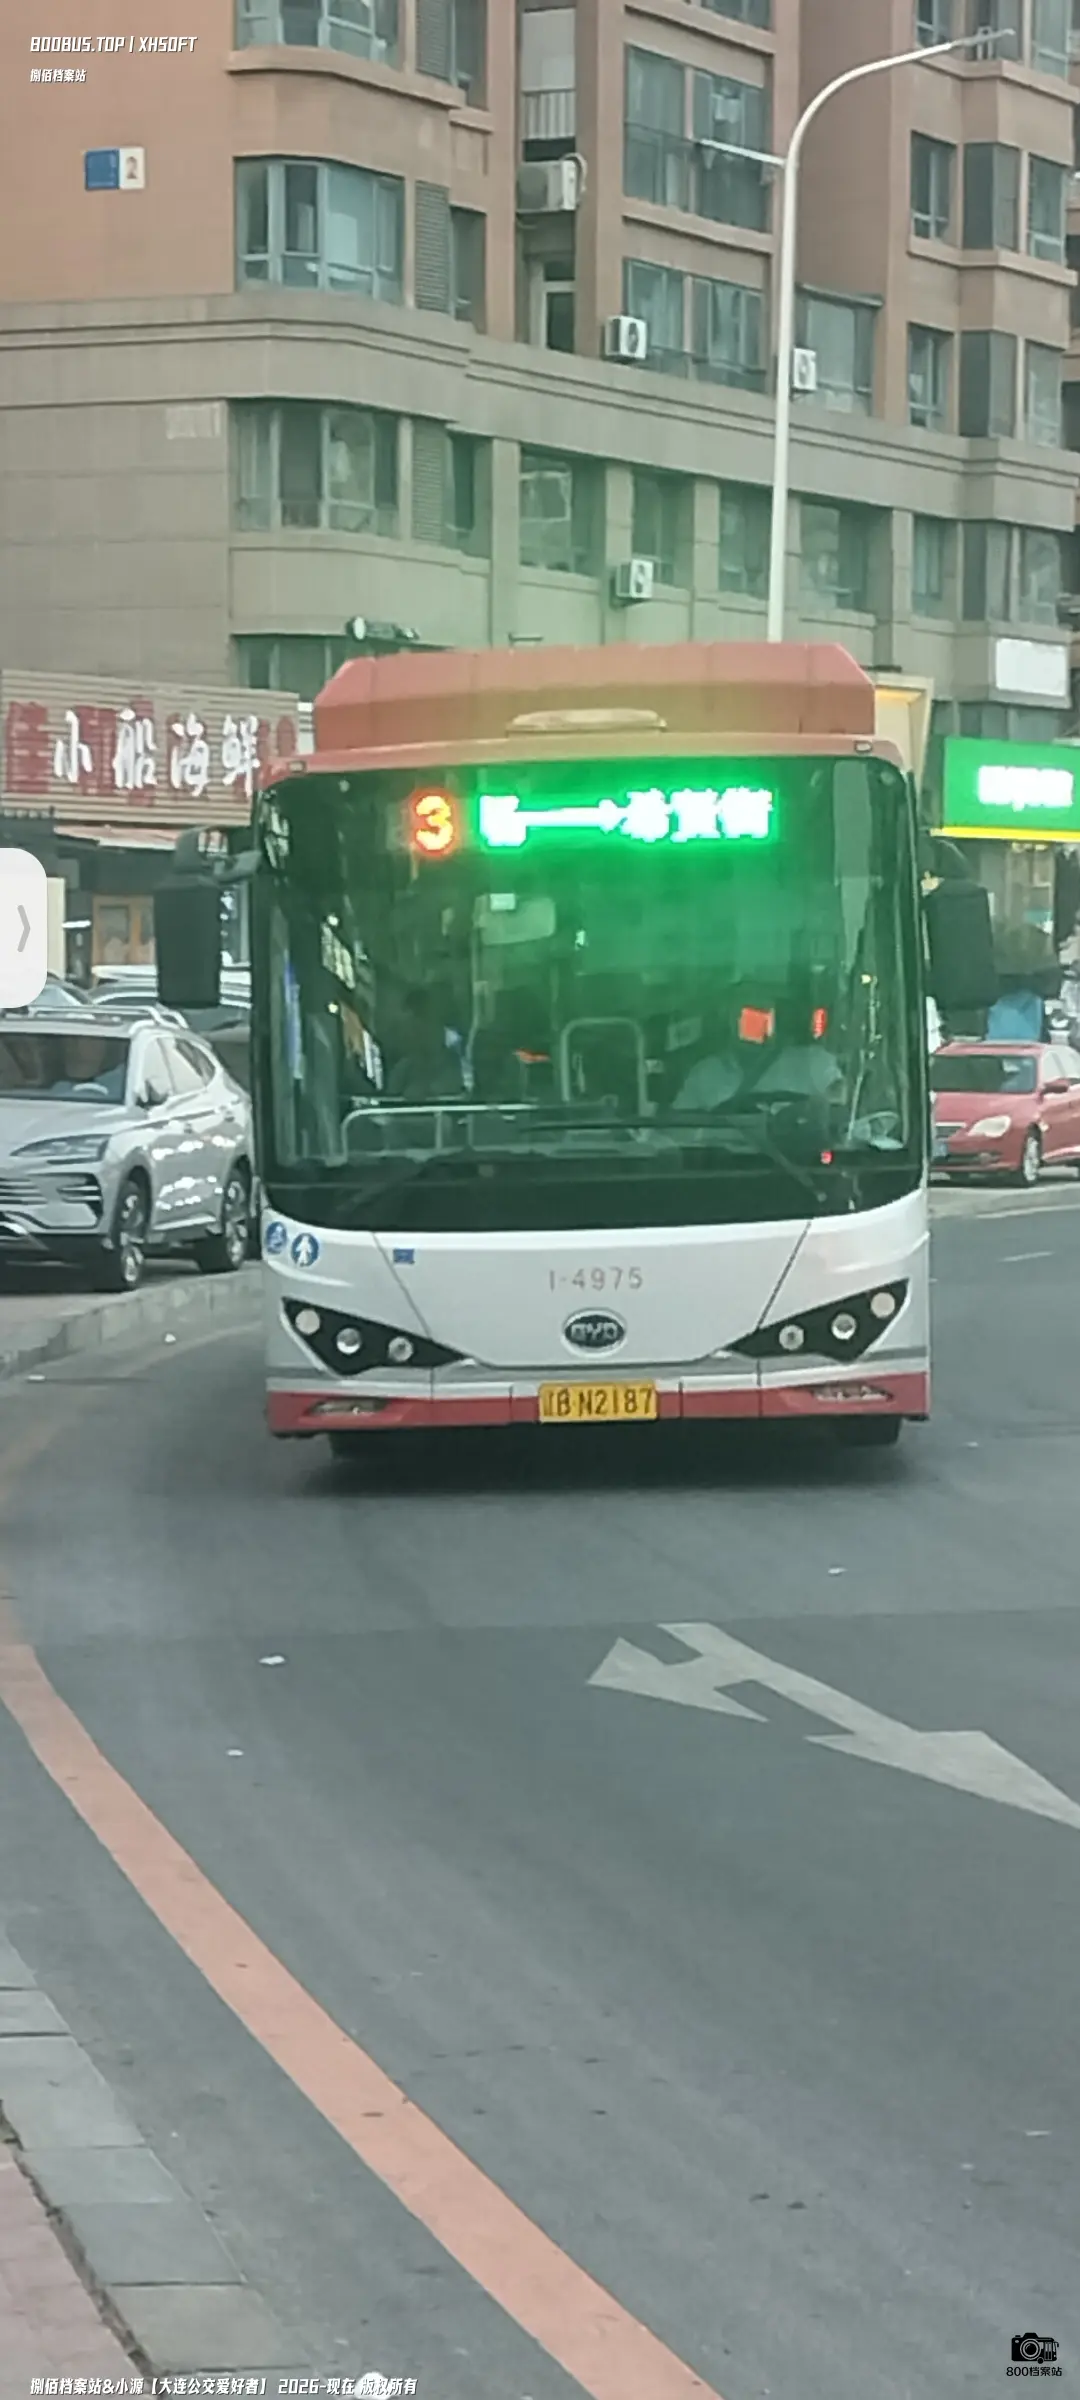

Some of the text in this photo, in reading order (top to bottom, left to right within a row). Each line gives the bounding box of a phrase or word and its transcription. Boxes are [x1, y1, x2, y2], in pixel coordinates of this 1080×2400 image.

[53, 708, 260, 798] 小船海鲜
[415, 795, 454, 851] 3
